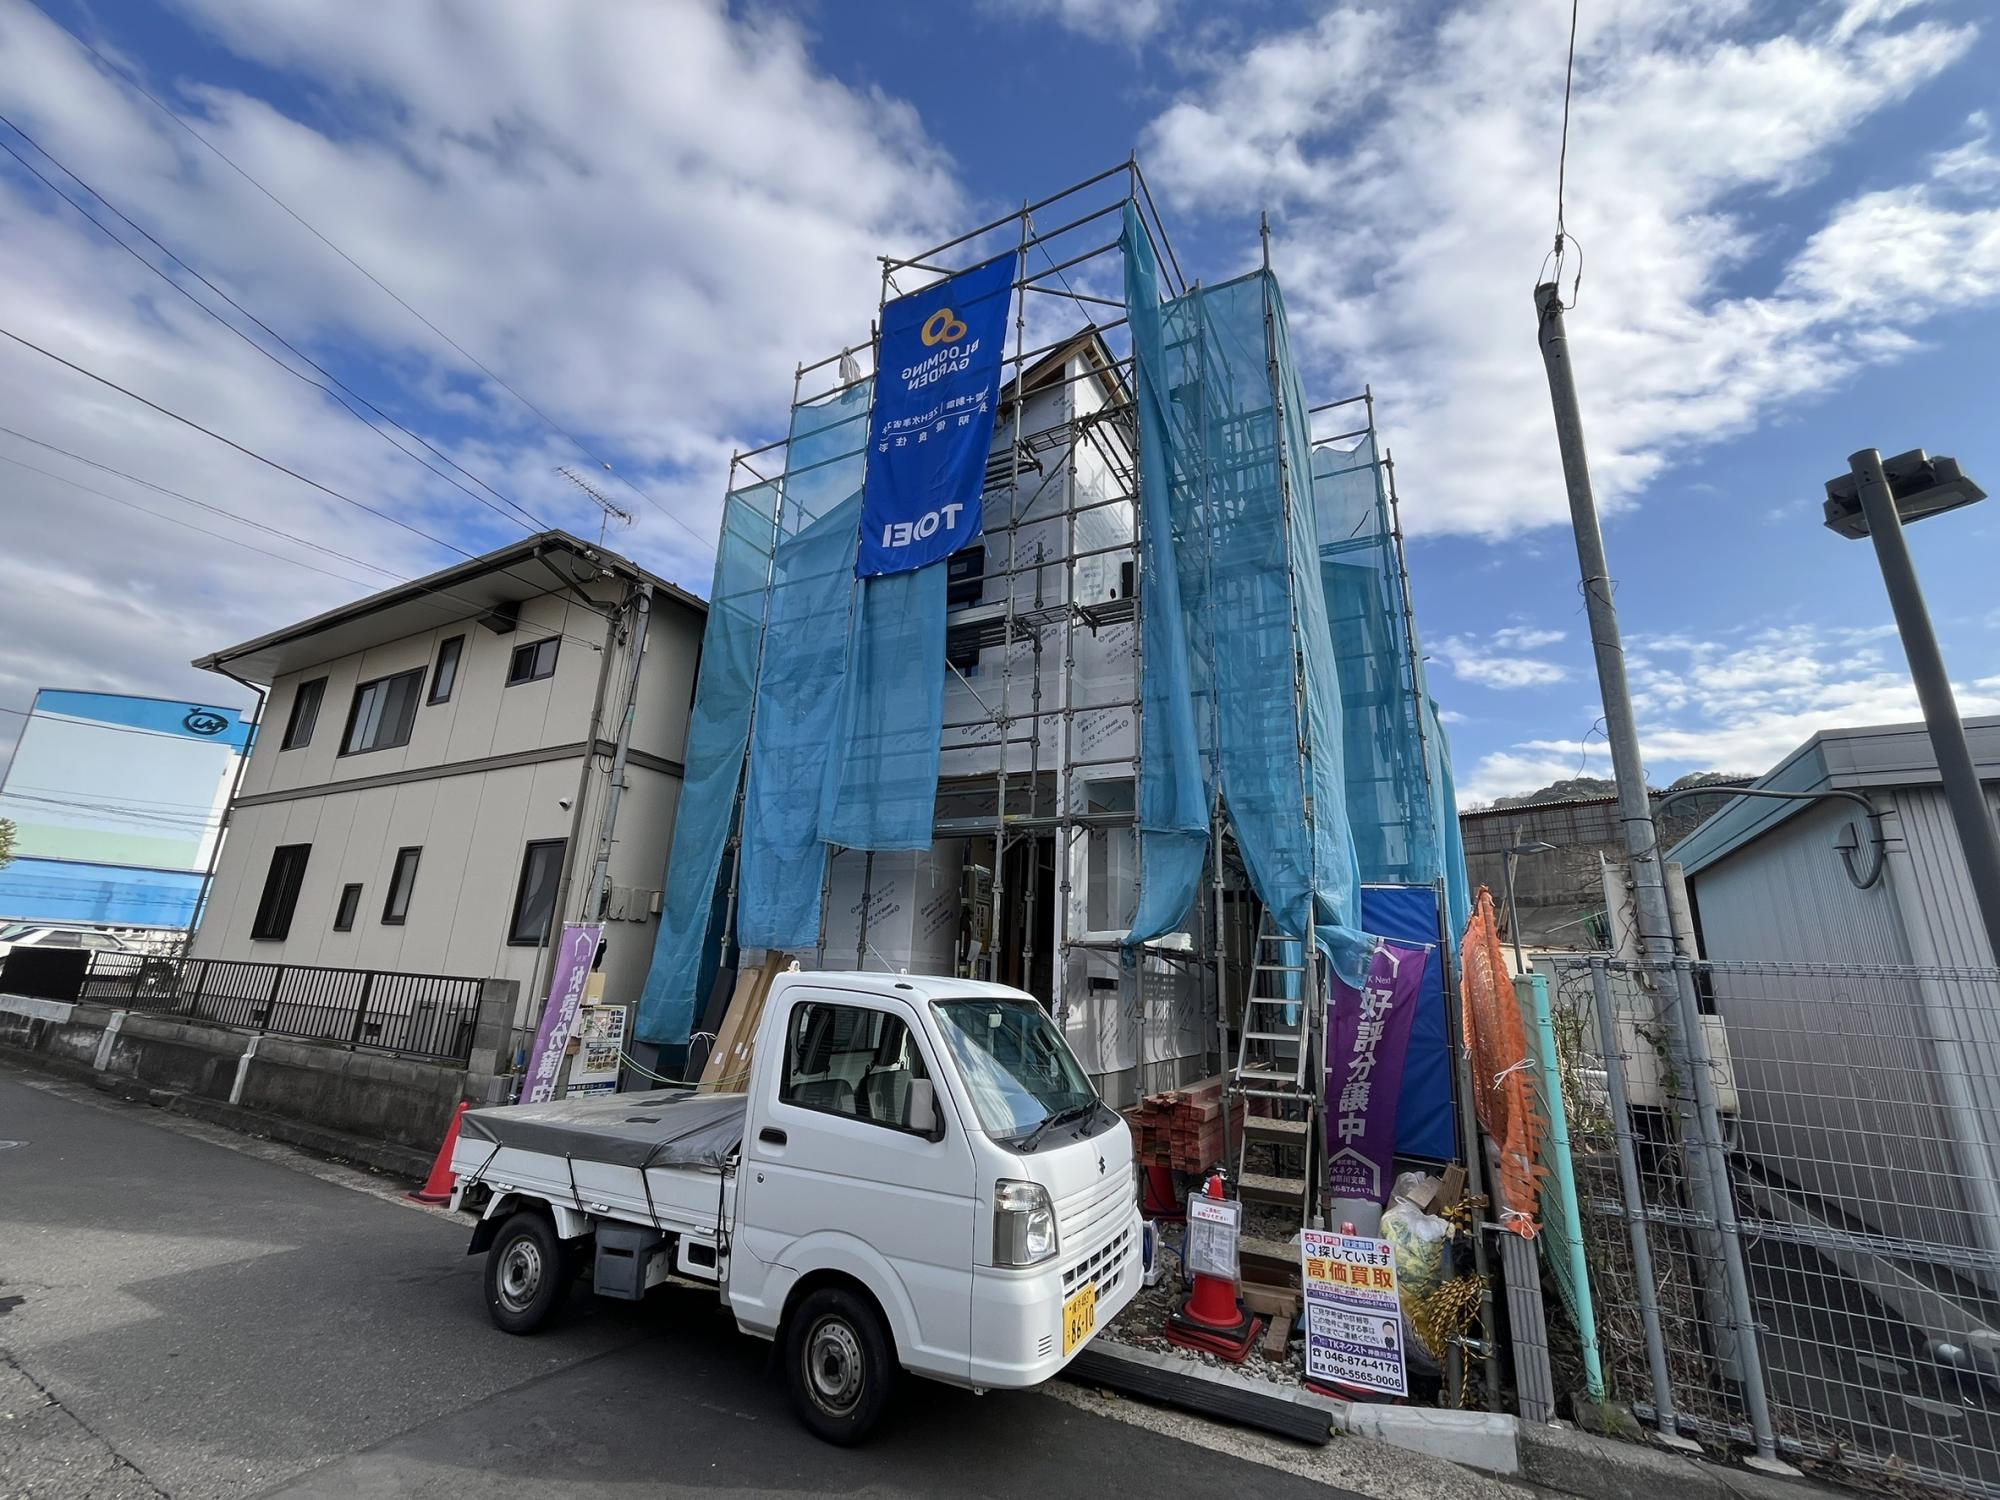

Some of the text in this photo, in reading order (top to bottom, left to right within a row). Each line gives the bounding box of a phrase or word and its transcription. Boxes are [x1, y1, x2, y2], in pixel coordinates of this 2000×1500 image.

[1338, 987, 1393, 1145] 好評分譲中
[1318, 1245, 1391, 1266] 探しています
[1307, 1258, 1393, 1288] 高価買取
[1328, 1338, 1367, 1355] TKネクスト
[1324, 1350, 1399, 1374] 046-874-4178
[1328, 1364, 1401, 1388] 090-5565-0006
